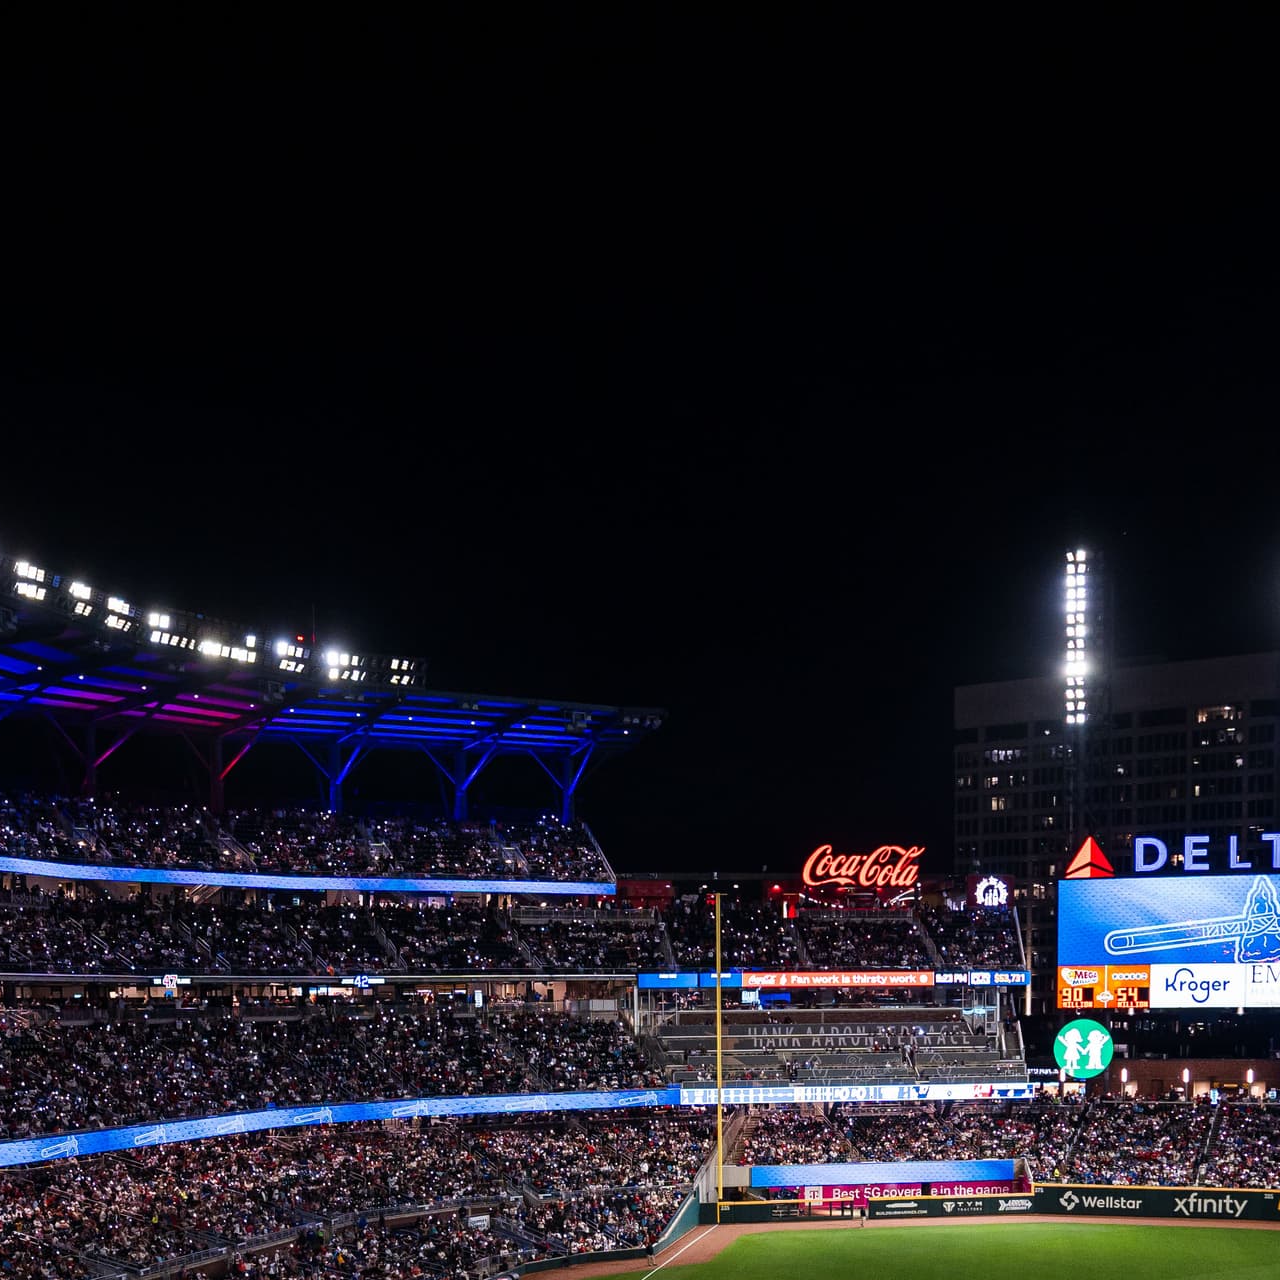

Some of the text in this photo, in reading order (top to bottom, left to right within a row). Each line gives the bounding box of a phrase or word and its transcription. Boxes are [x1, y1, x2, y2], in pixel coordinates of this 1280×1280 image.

[802, 844, 925, 887] Coca-Cola
[162, 974, 177, 989] 47
[354, 975, 369, 989] 42
[791, 974, 811, 985] Fan
[814, 974, 839, 985] work
[841, 974, 850, 985] is
[852, 974, 885, 987] thirsty
[887, 974, 916, 985] work
[1166, 968, 1230, 1003] Kroger
[1062, 987, 1084, 1002] 90
[1116, 987, 1139, 1002] 54
[747, 1027, 971, 1048] HANK AARON TERRACE
[833, 1187, 860, 1200] Best
[863, 1187, 881, 1199] 5G
[882, 1187, 938, 1199] coverae
[940, 1185, 951, 1196] in
[953, 1184, 973, 1195] the
[975, 1185, 1010, 1196] game
[1082, 1194, 1143, 1210] Wellstar
[1174, 1194, 1248, 1218] xfinity
